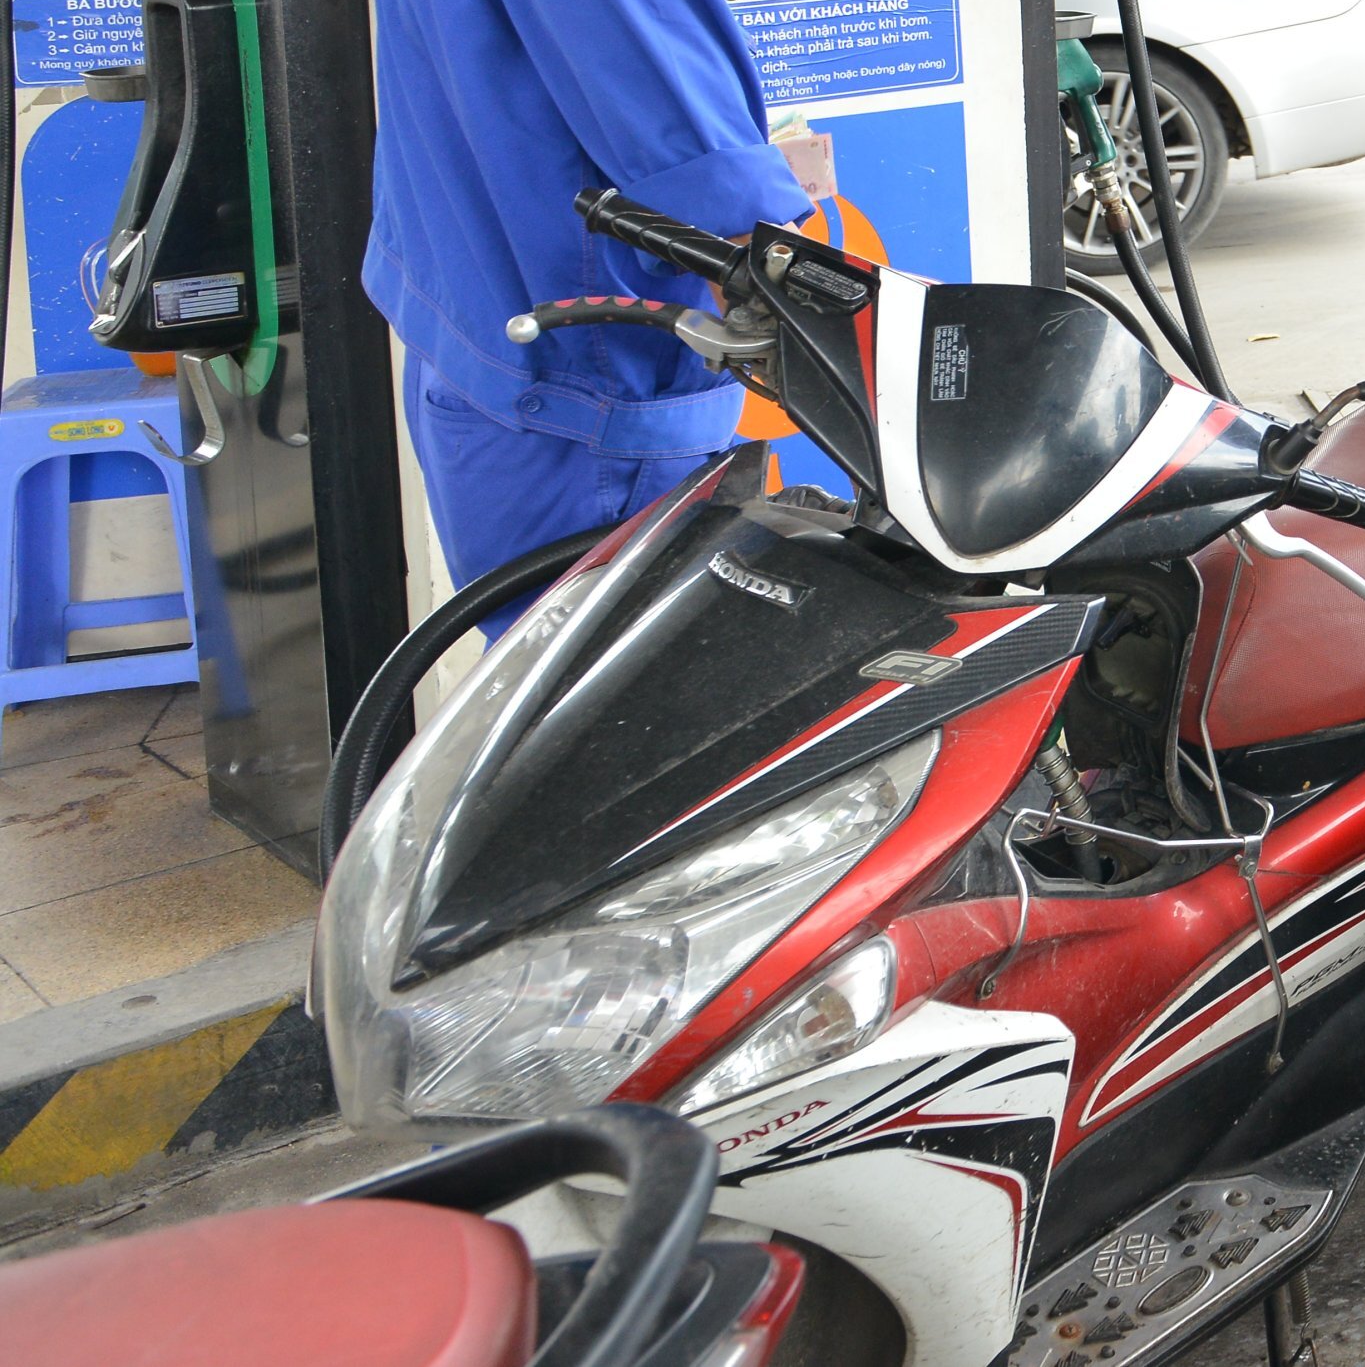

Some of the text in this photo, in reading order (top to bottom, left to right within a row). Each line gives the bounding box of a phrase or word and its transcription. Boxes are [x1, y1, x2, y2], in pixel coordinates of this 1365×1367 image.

[67, 0, 91, 10] BA
[779, 7, 807, 21] VỚI
[810, 1, 863, 19] KHÁCH
[47, 17, 54, 28] 1
[72, 16, 103, 26] Đưa
[762, 28, 801, 43] khách
[805, 24, 838, 39] nhận
[841, 19, 876, 33] trước
[879, 16, 897, 29] khi
[900, 15, 932, 28] bơm.
[48, 27, 143, 42] 2 Giữ nguyê
[48, 45, 57, 55] 3
[74, 43, 105, 54] Cảm
[110, 44, 128, 53] ơn
[767, 30, 933, 58] khách phải trả sau khi bơm.
[40, 58, 131, 70] Mong quý khách
[761, 61, 792, 75] dịch.
[833, 69, 858, 81] hoặc
[898, 61, 915, 73] dây
[918, 58, 946, 70] nóng)
[776, 86, 790, 98] tốt
[792, 86, 813, 96] hơn
[708, 551, 794, 604] HONDA
[716, 1100, 832, 1153] ONDA
